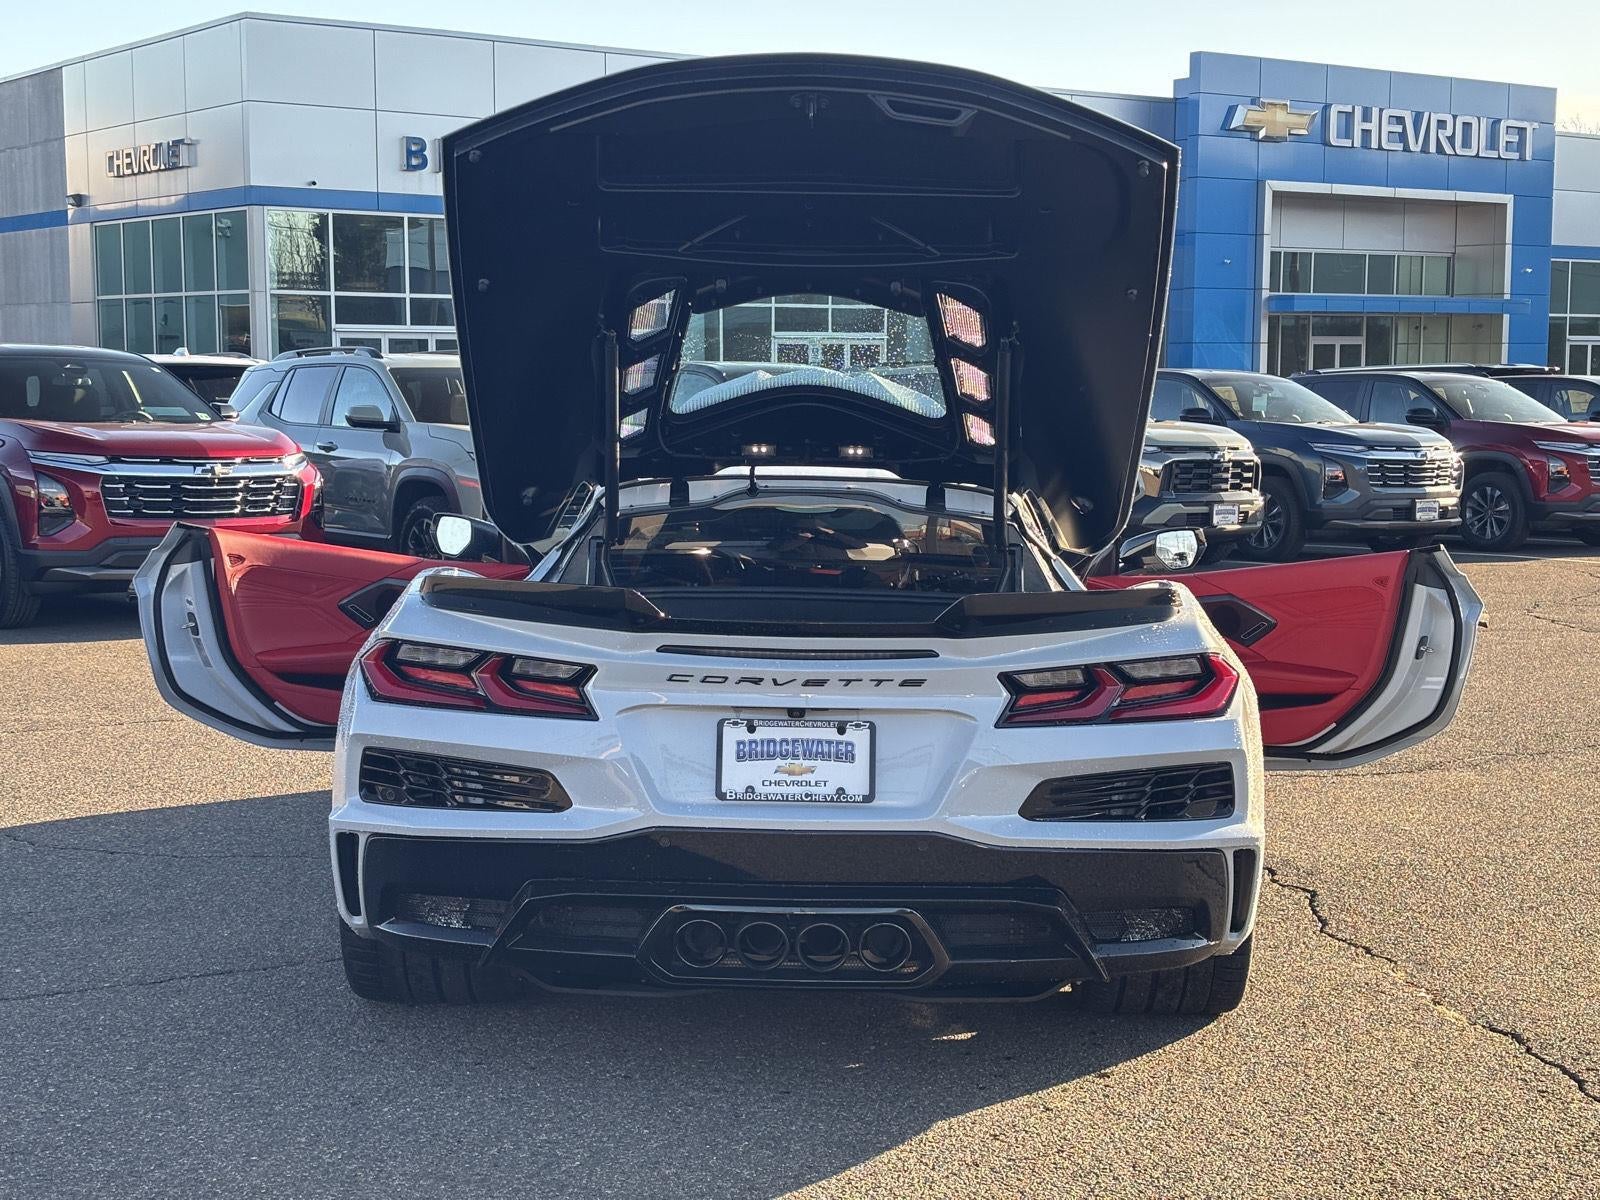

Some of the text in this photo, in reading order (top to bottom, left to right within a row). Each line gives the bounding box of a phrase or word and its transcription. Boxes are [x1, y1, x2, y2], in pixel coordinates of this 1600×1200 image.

[1328, 103, 1540, 161] CHEVROLET
[105, 138, 191, 177] CHEVROLET
[666, 673, 928, 688] CORVETTE
[735, 738, 857, 764] BRIDGEWATER
[761, 779, 830, 788] CHEVROLET
[726, 789, 864, 803] BRIDGEWATERCHEVY.COM
